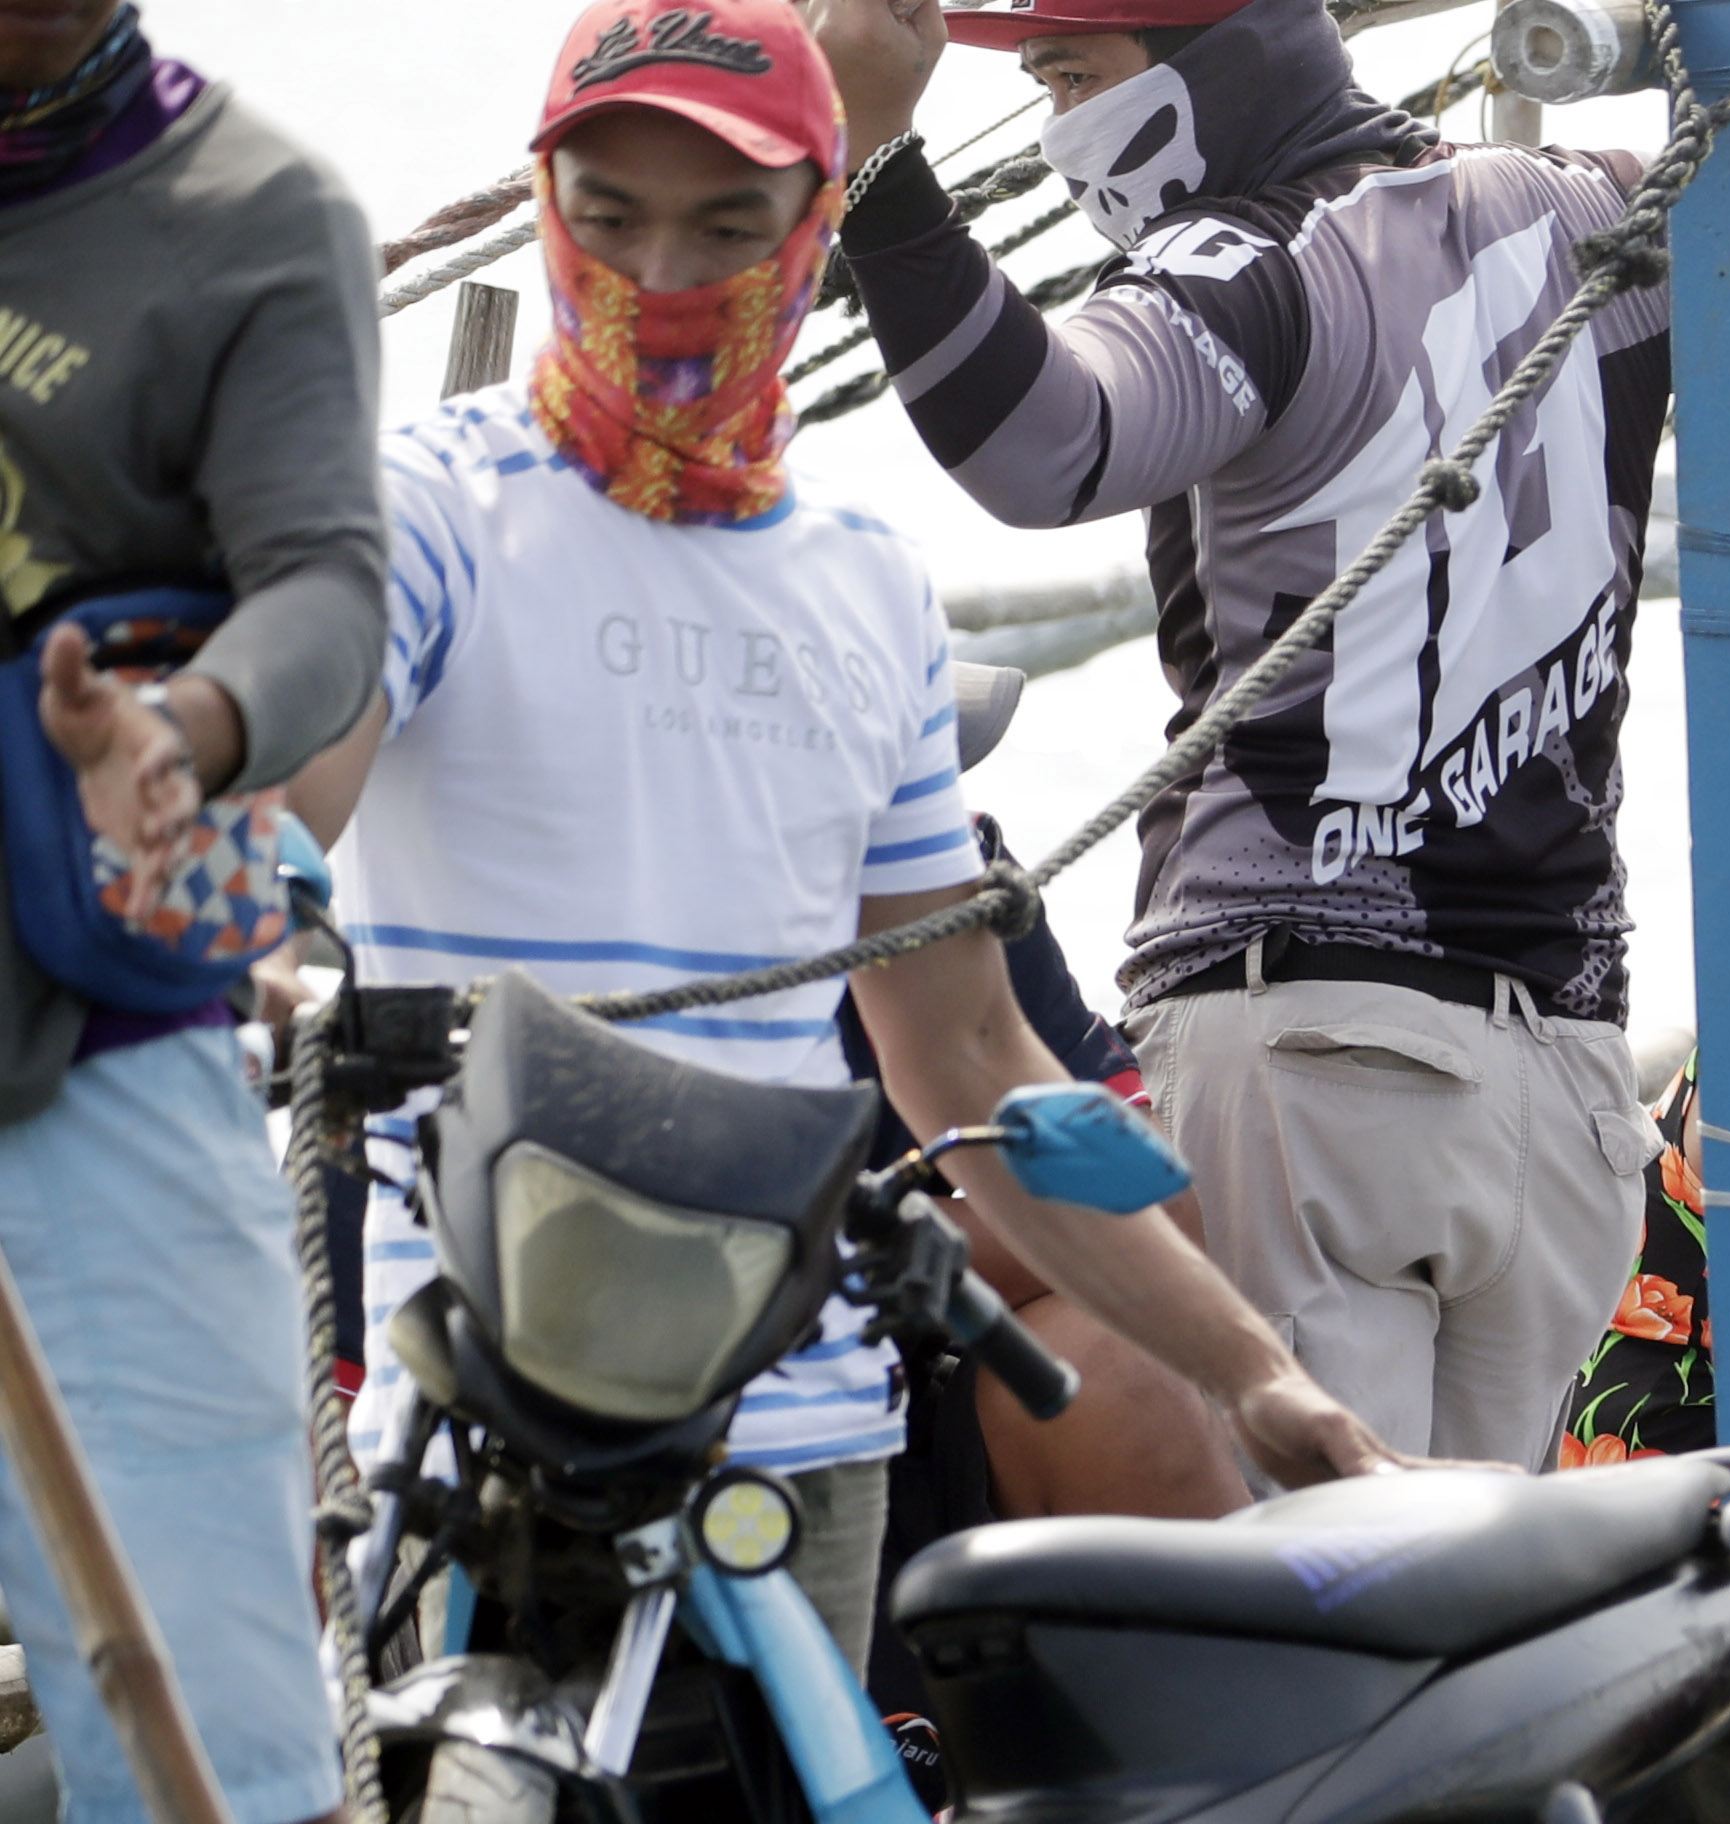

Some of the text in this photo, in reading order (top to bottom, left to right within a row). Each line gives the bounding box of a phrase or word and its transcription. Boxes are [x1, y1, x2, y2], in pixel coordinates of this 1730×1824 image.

[597, 610, 874, 715] GUESS
[1311, 590, 1619, 887] ONE GARAGE
